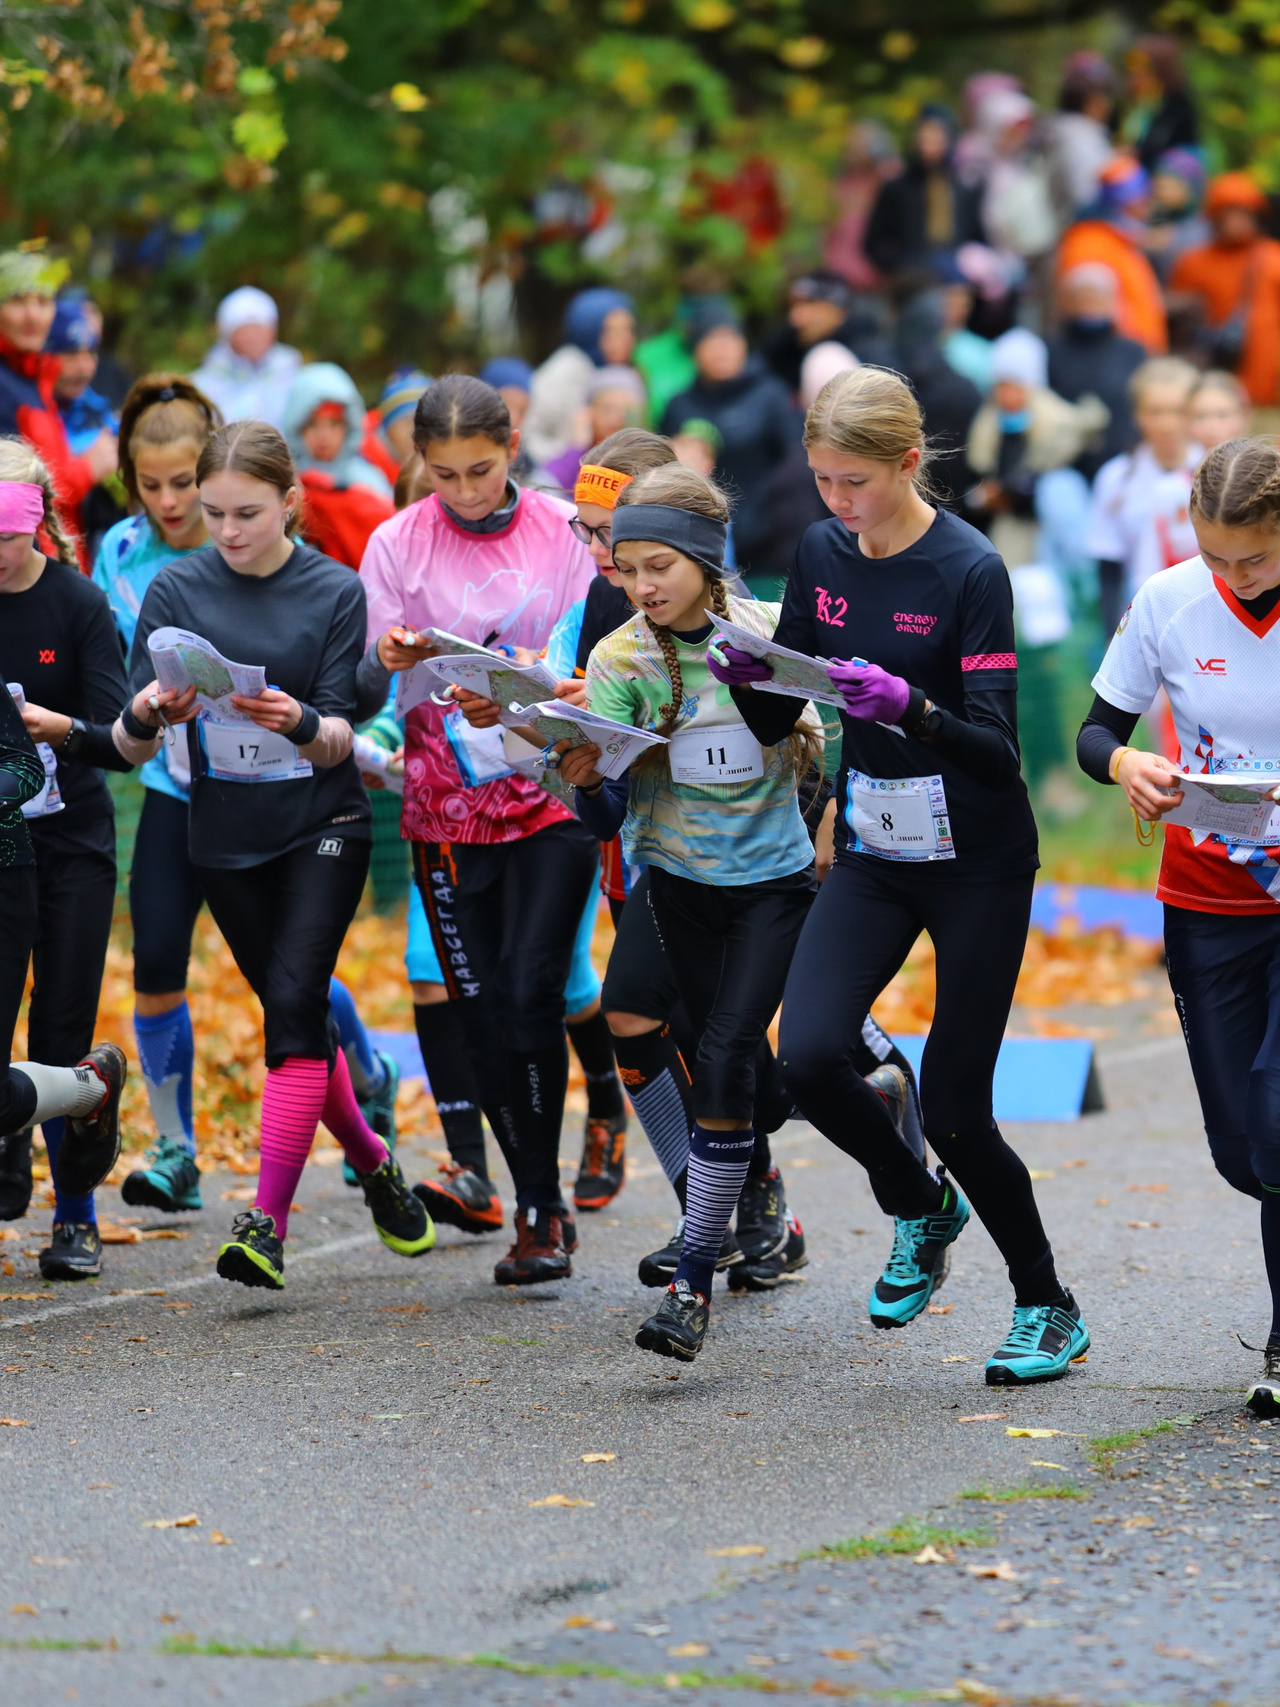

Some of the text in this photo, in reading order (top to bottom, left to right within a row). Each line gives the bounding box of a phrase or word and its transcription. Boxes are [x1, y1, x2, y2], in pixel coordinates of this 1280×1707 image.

[814, 586, 849, 628] K2
[893, 612, 938, 627] ENERGY
[895, 623, 931, 636] GROUP
[238, 744, 261, 760] 17
[704, 746, 728, 766] 11
[718, 768, 723, 776] 1
[725, 765, 754, 776] линия
[881, 812, 894, 832] 8
[890, 834, 895, 842] 1
[431, 870, 481, 997] НАВСЕГДА
